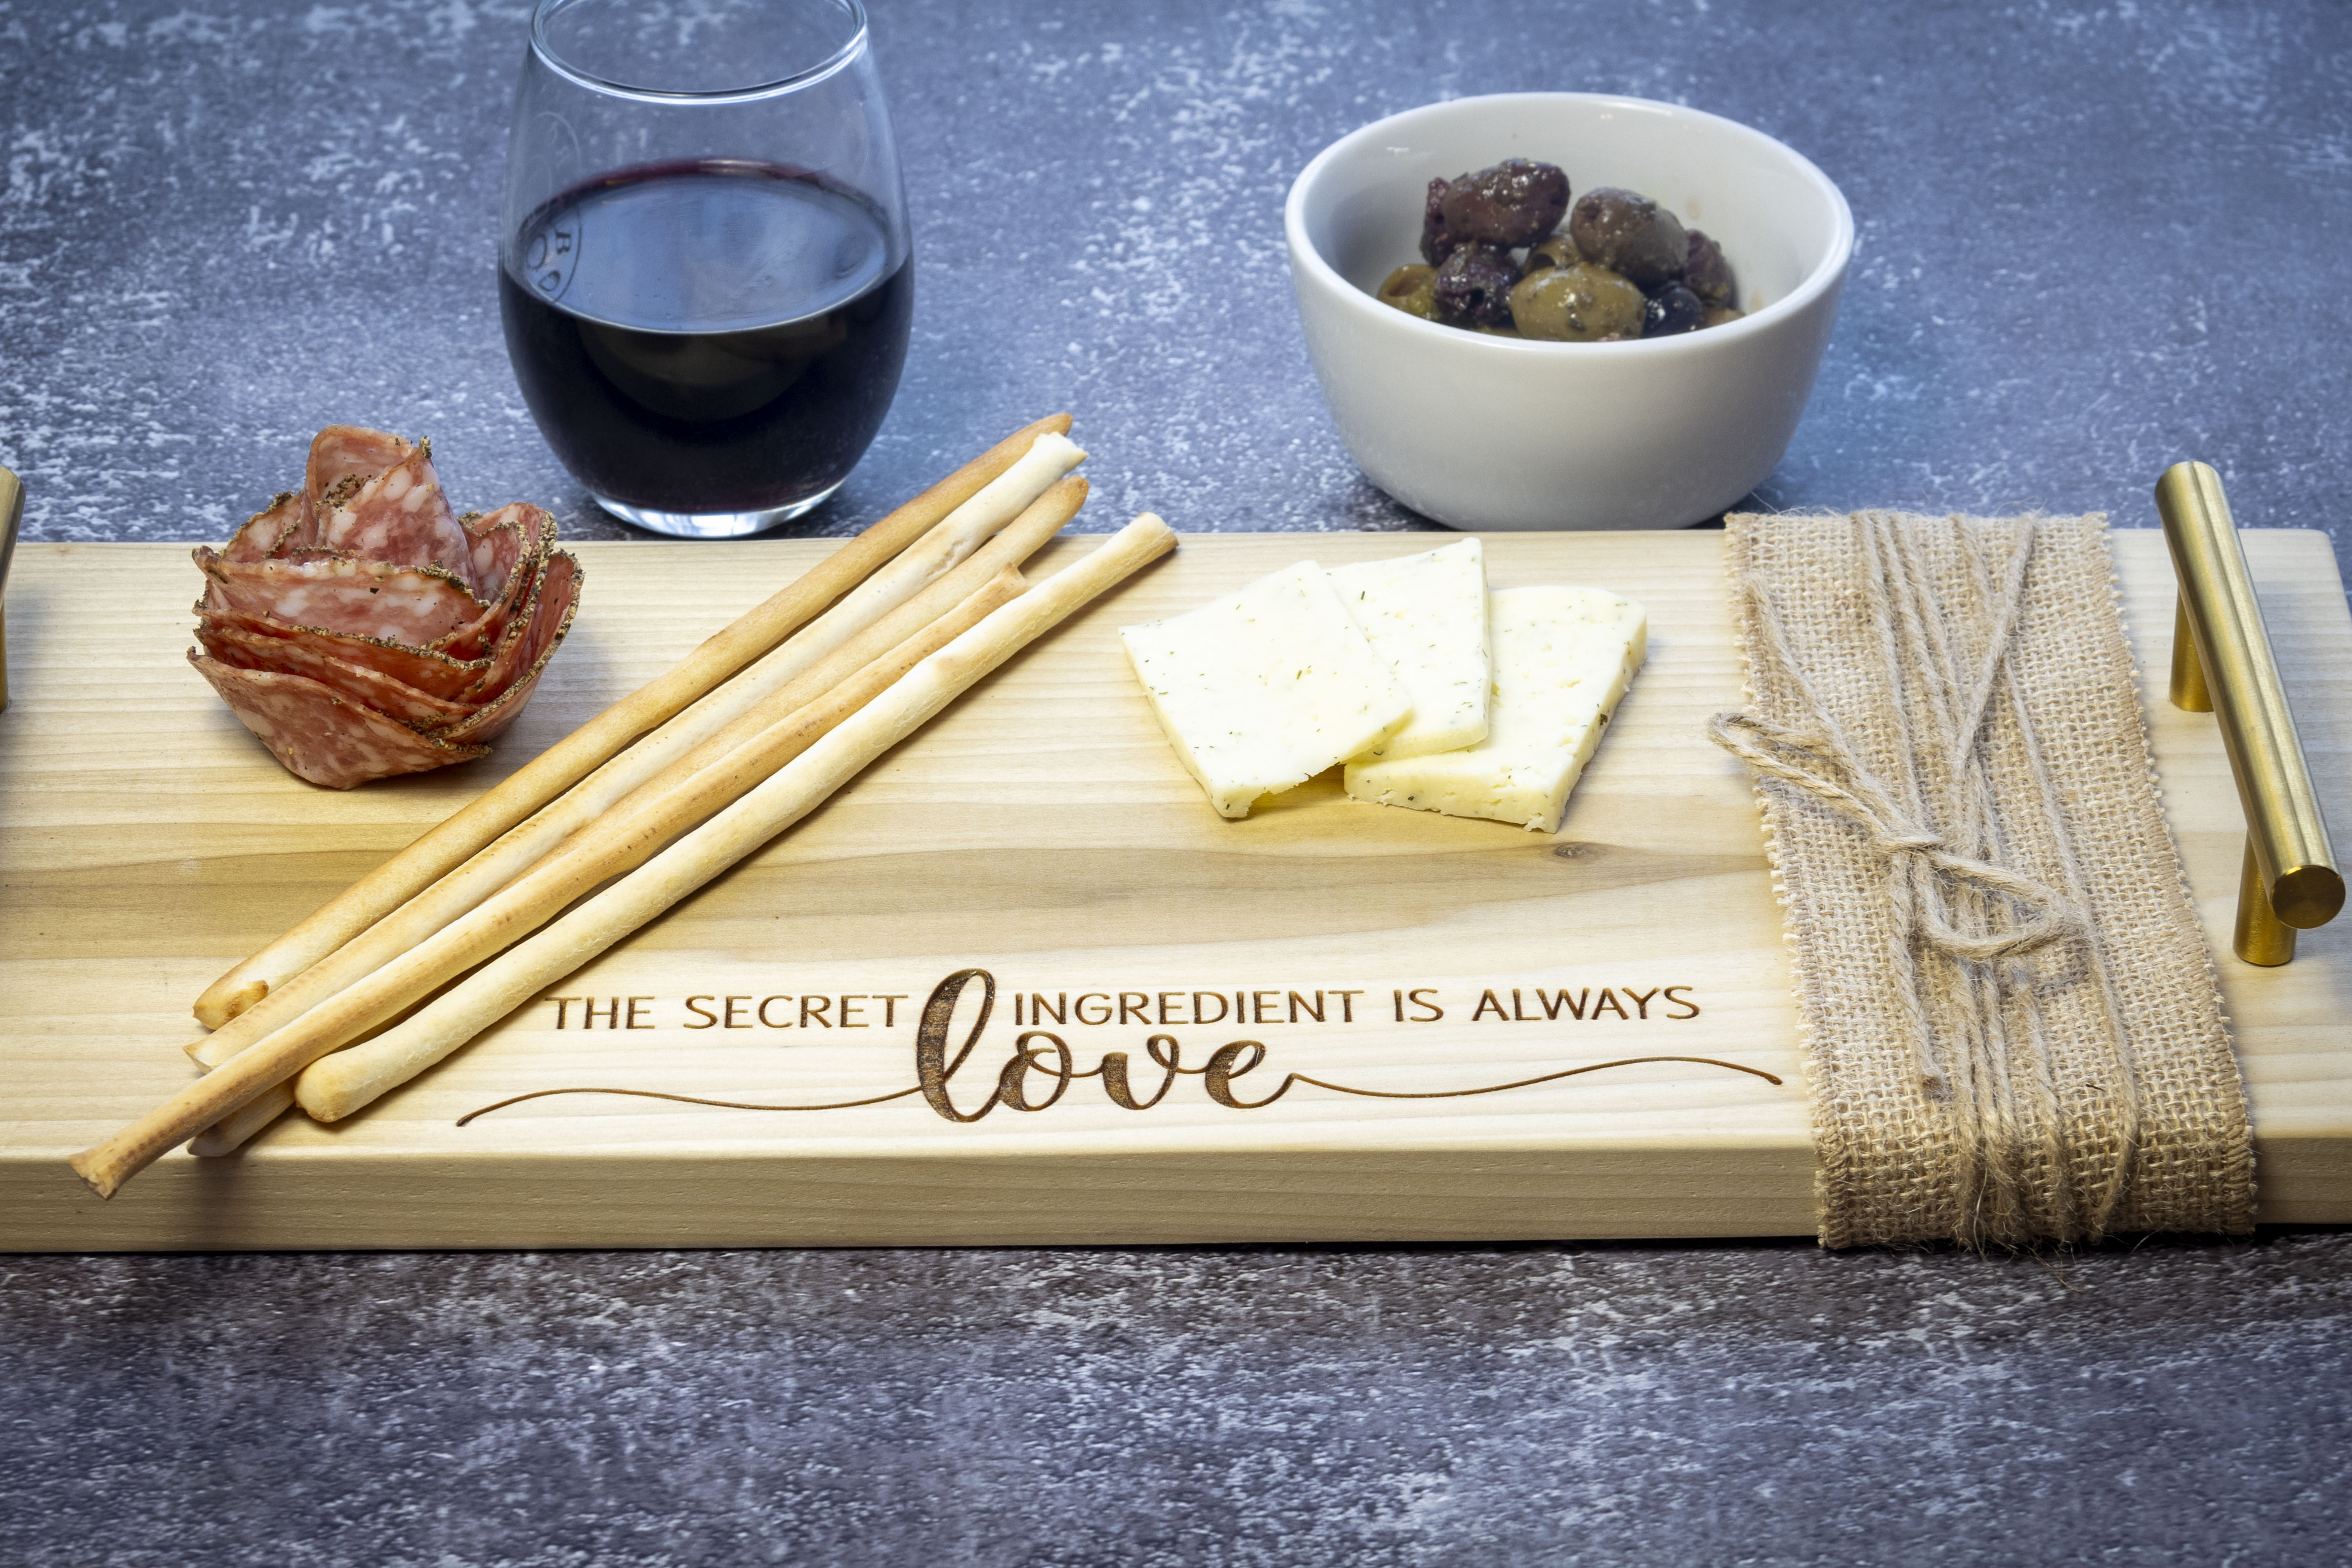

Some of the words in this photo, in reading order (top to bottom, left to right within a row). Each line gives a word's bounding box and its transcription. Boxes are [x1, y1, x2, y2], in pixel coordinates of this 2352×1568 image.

[545, 995, 655, 1029] THE
[683, 994, 908, 1029] SECRET
[1015, 990, 1364, 1025] INGREDIENT
[1393, 988, 1444, 1022] IS
[1471, 985, 1701, 1022] ALWAYS
[917, 967, 1294, 1123] love
